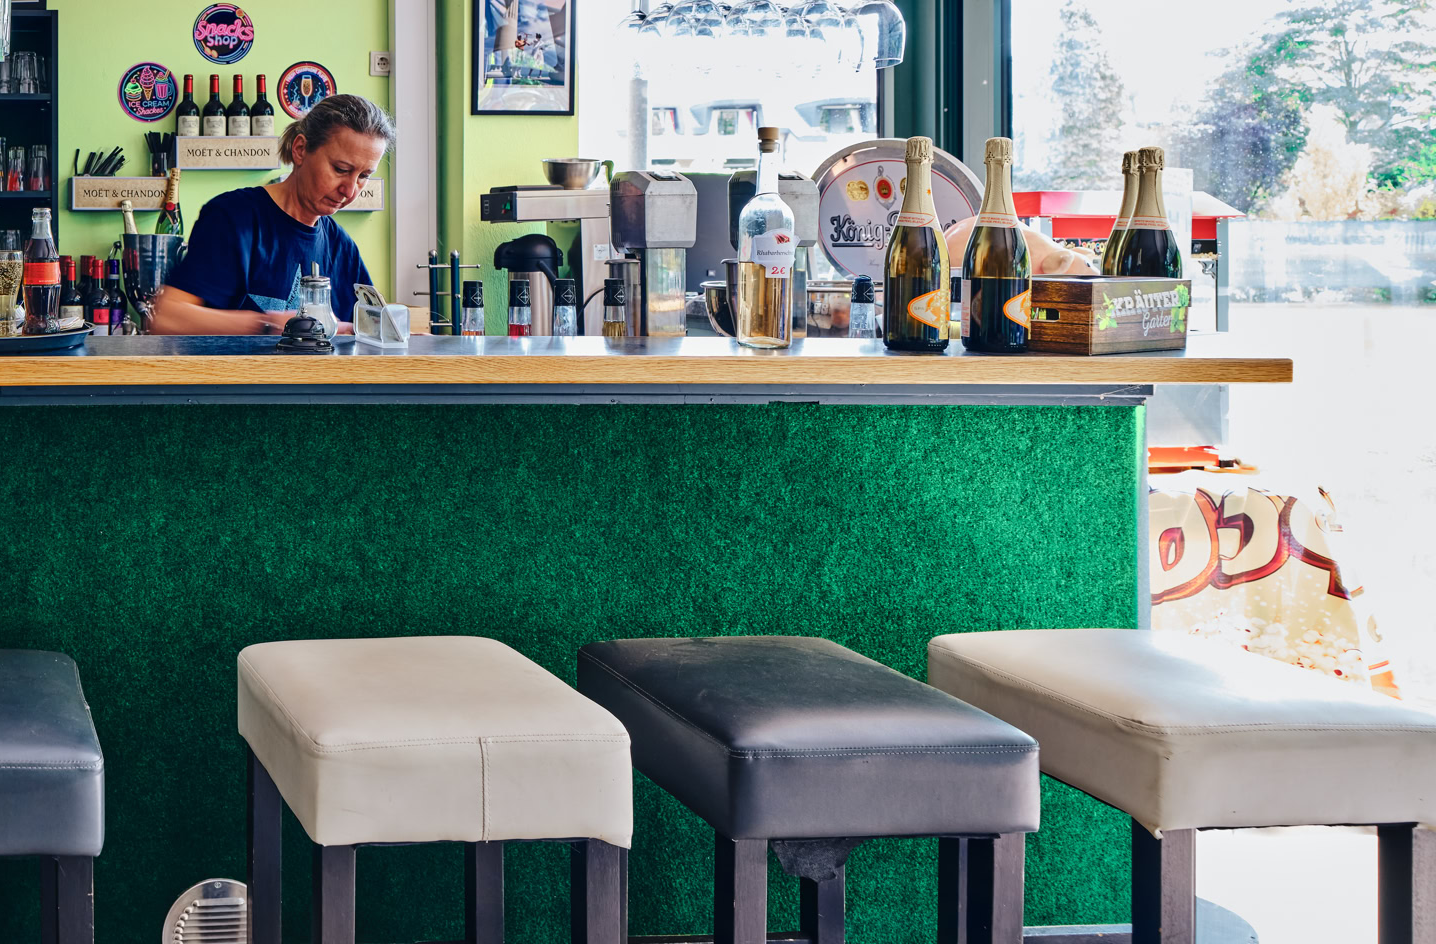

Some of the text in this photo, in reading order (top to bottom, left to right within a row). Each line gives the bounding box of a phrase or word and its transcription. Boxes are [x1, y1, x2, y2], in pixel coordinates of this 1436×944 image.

[194, 19, 254, 41] Snacks
[206, 34, 238, 49] Shop
[186, 147, 271, 157] MOËT & CHANDON
[82, 188, 167, 198] MOËT & CHANDON
[1111, 289, 1180, 313] KRÄUTER
[1142, 312, 1173, 336] Garten
